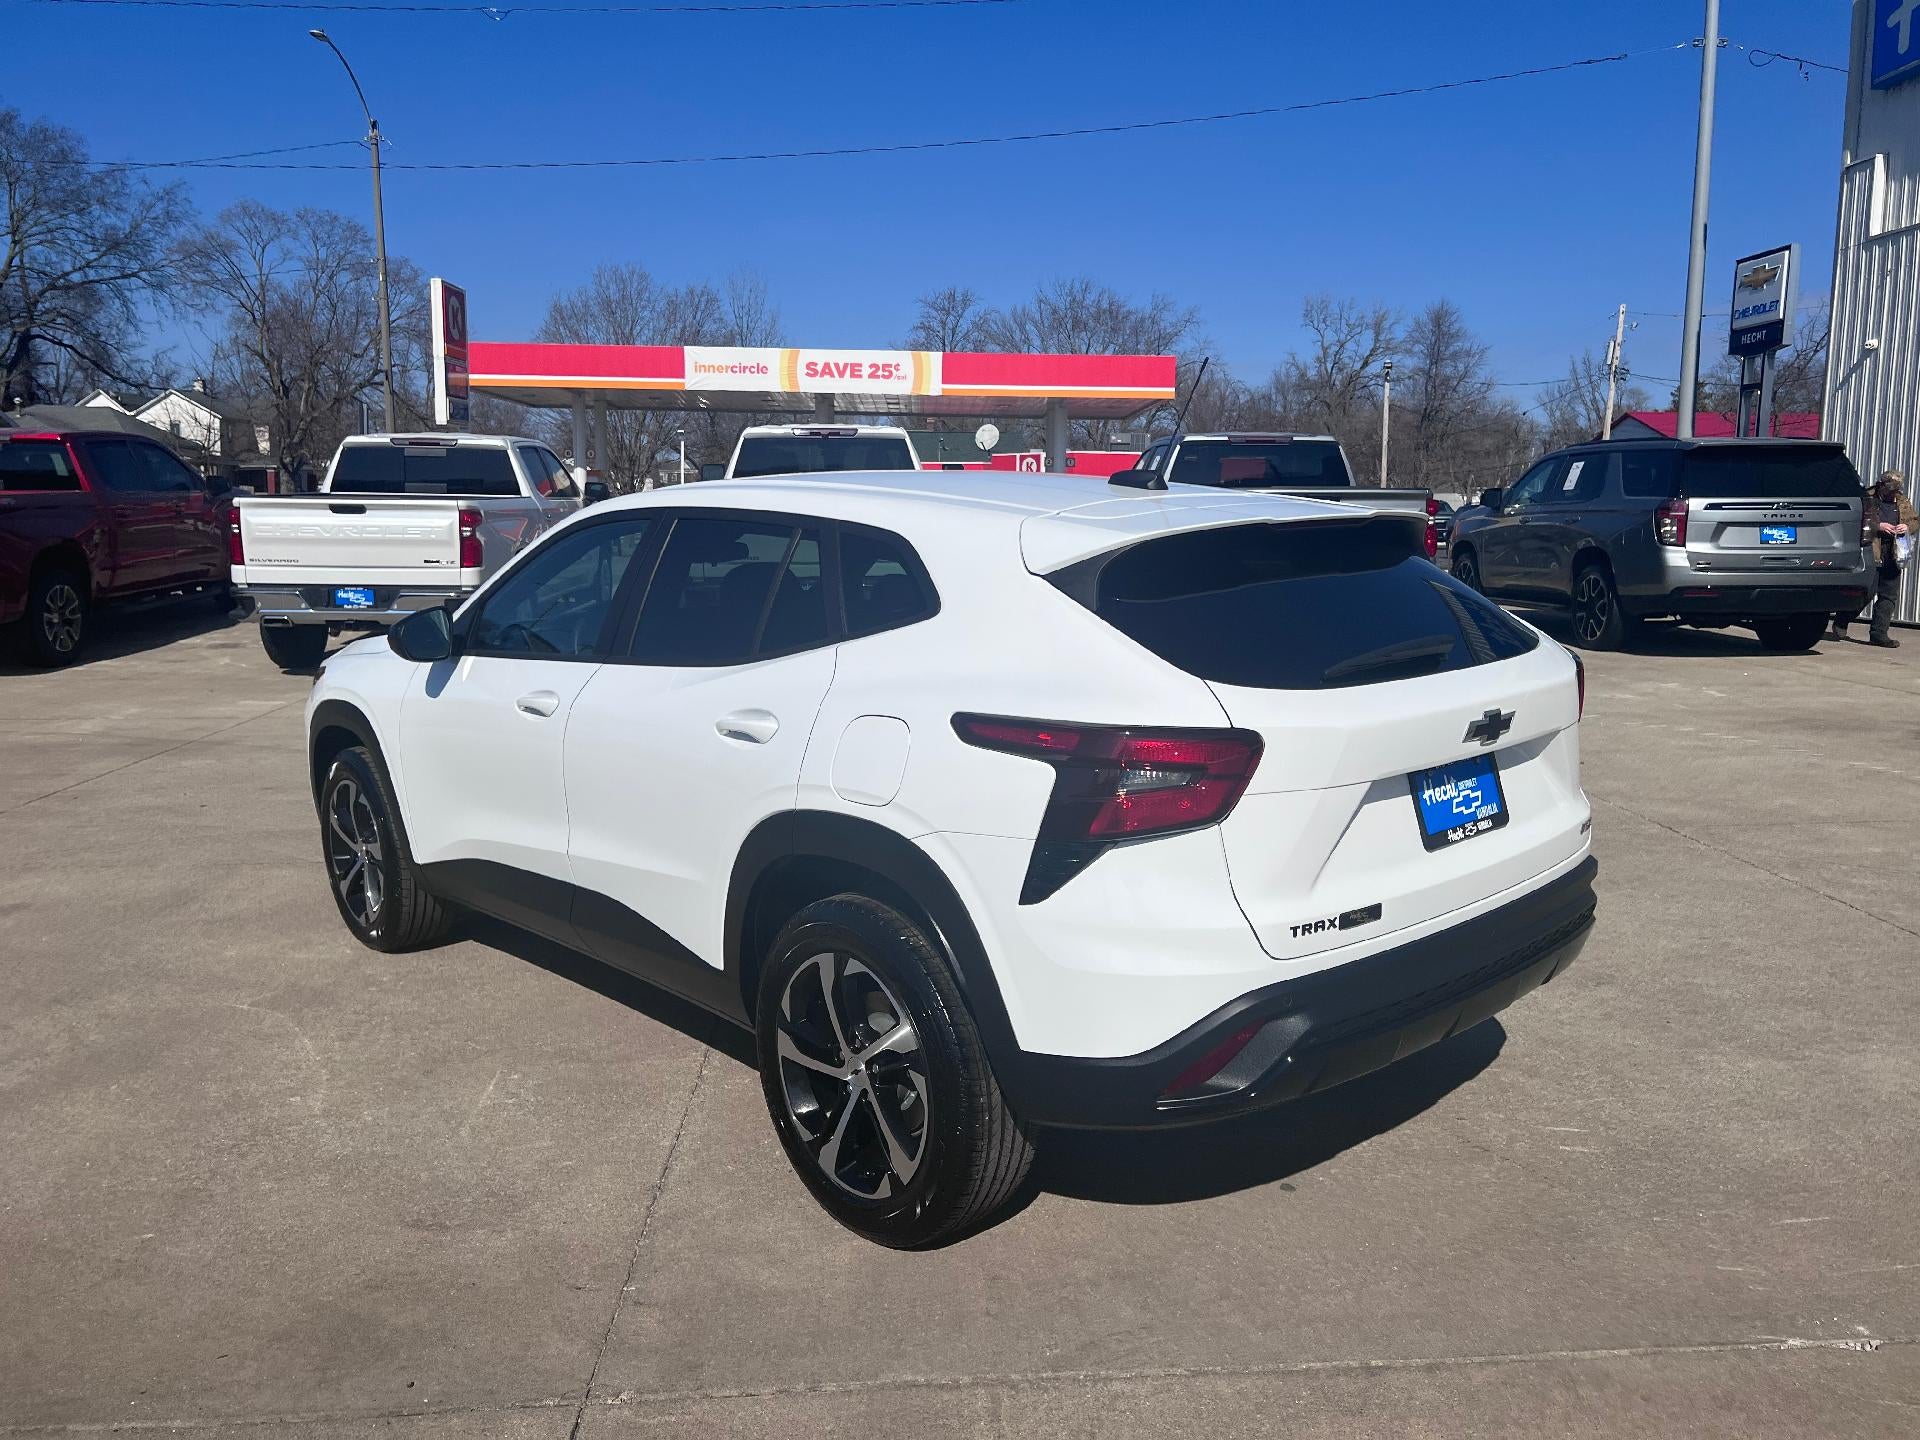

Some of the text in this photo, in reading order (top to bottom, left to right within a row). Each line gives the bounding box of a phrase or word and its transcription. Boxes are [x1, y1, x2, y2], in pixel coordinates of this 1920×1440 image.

[1734, 299, 1780, 320] CHEVROLET
[1741, 330, 1767, 345] HECHT
[693, 360, 769, 375] innercircle
[805, 361, 863, 379] SAVE
[255, 525, 444, 539] CHEVROLET
[1423, 774, 1459, 806] Hecht
[1290, 916, 1338, 938] TRAX
